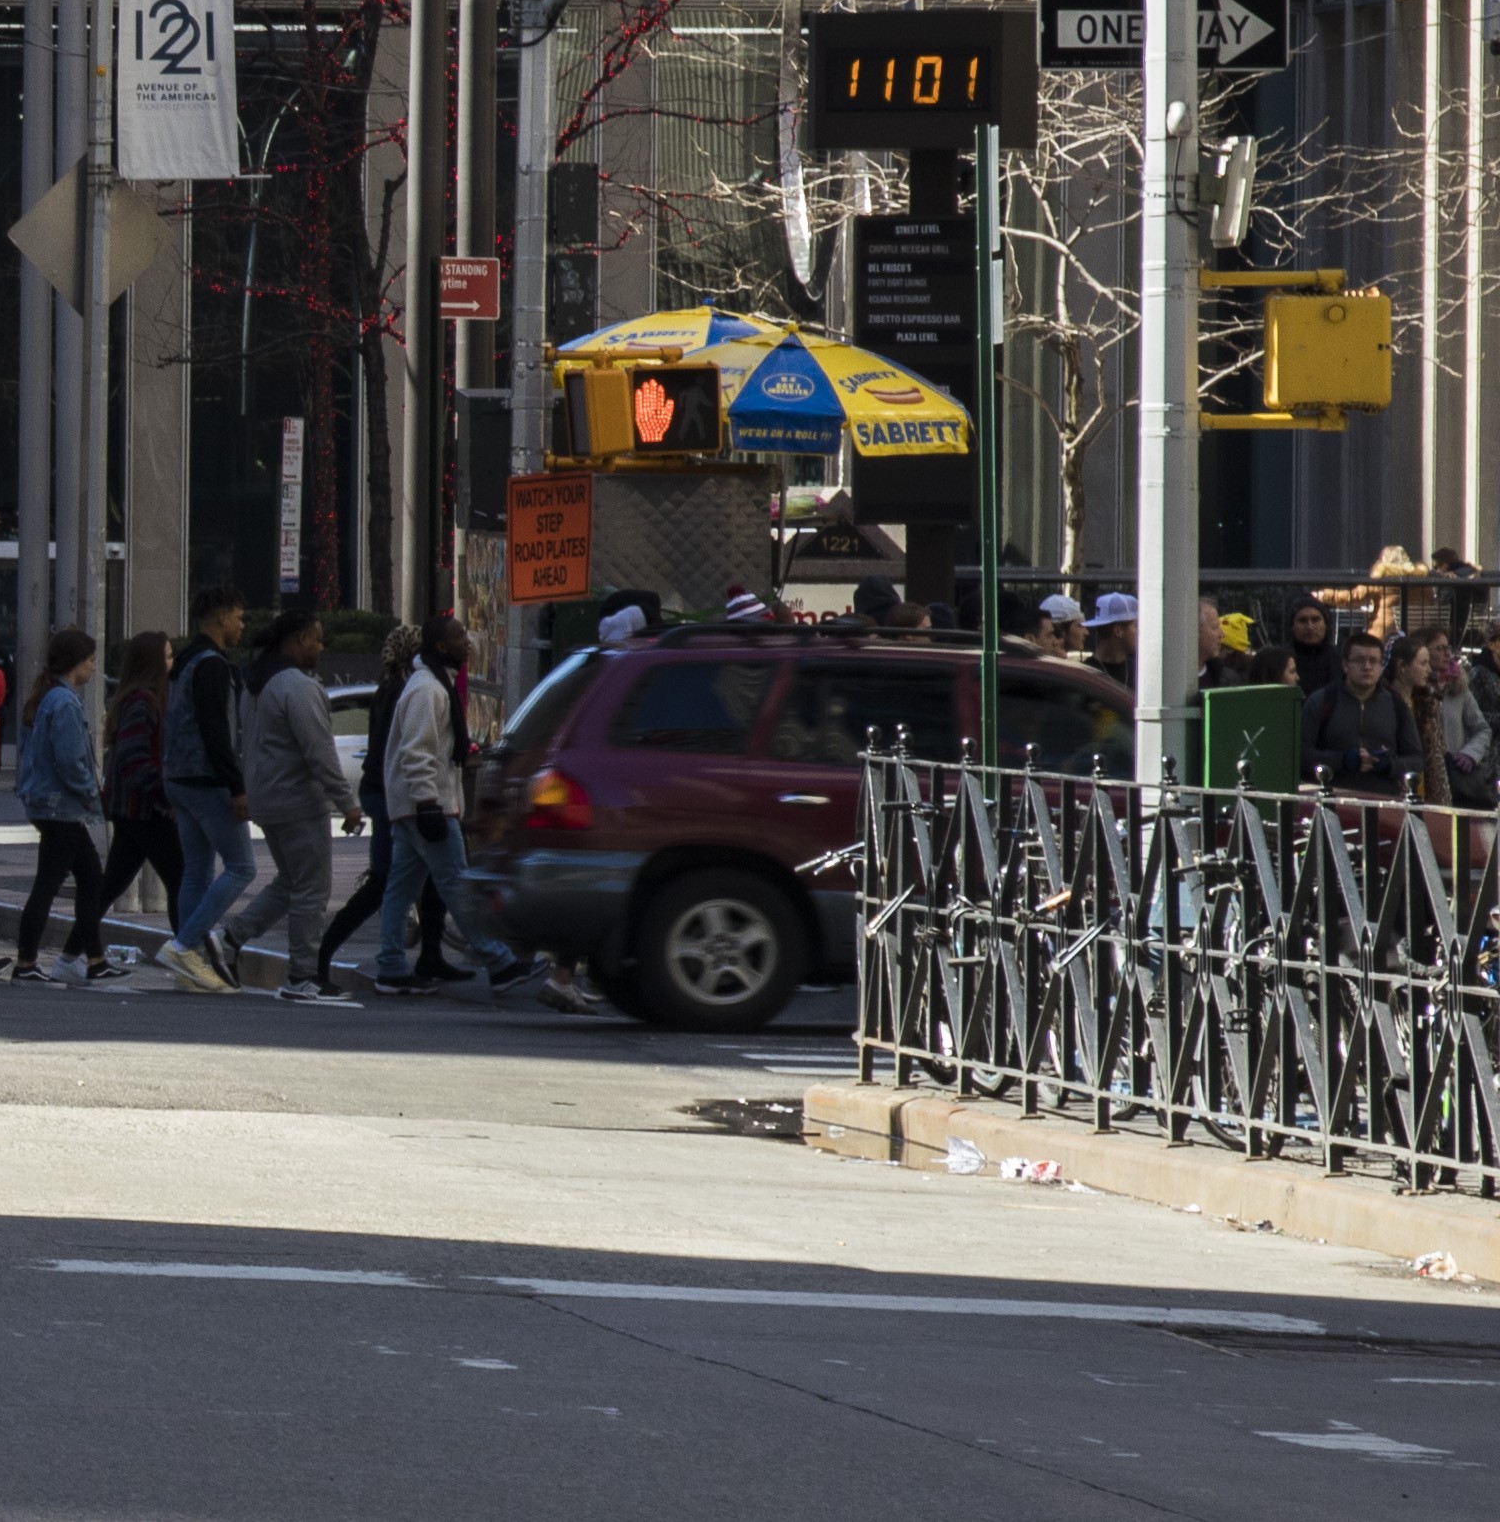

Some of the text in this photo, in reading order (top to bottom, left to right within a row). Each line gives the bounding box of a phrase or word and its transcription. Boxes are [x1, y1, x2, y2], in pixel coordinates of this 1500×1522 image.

[1077, 14, 1250, 44] ONE AY
[136, 83, 198, 91] AVENUE OF
[850, 56, 978, 104] 1101
[136, 93, 217, 101] THE AMERICAS
[895, 224, 940, 235] STREET LEVEL
[446, 264, 488, 276] STANDING
[868, 263, 880, 273] DEL
[442, 277, 467, 290] ytime
[868, 314, 961, 324] ZIBETTO ESPRESSO BAR
[603, 331, 699, 345] SABRETT
[896, 332, 939, 342] PLAZA LEVEL
[839, 371, 897, 394] SABRETT
[771, 430, 784, 439] ON
[795, 431, 819, 441] ROLL
[855, 421, 961, 446] SABRETT
[516, 484, 586, 509] WATCH YOUR
[537, 513, 563, 534] STEP
[515, 538, 586, 562] ROAD PLATES
[822, 536, 859, 552] 1221
[533, 565, 567, 587] AHEAD
